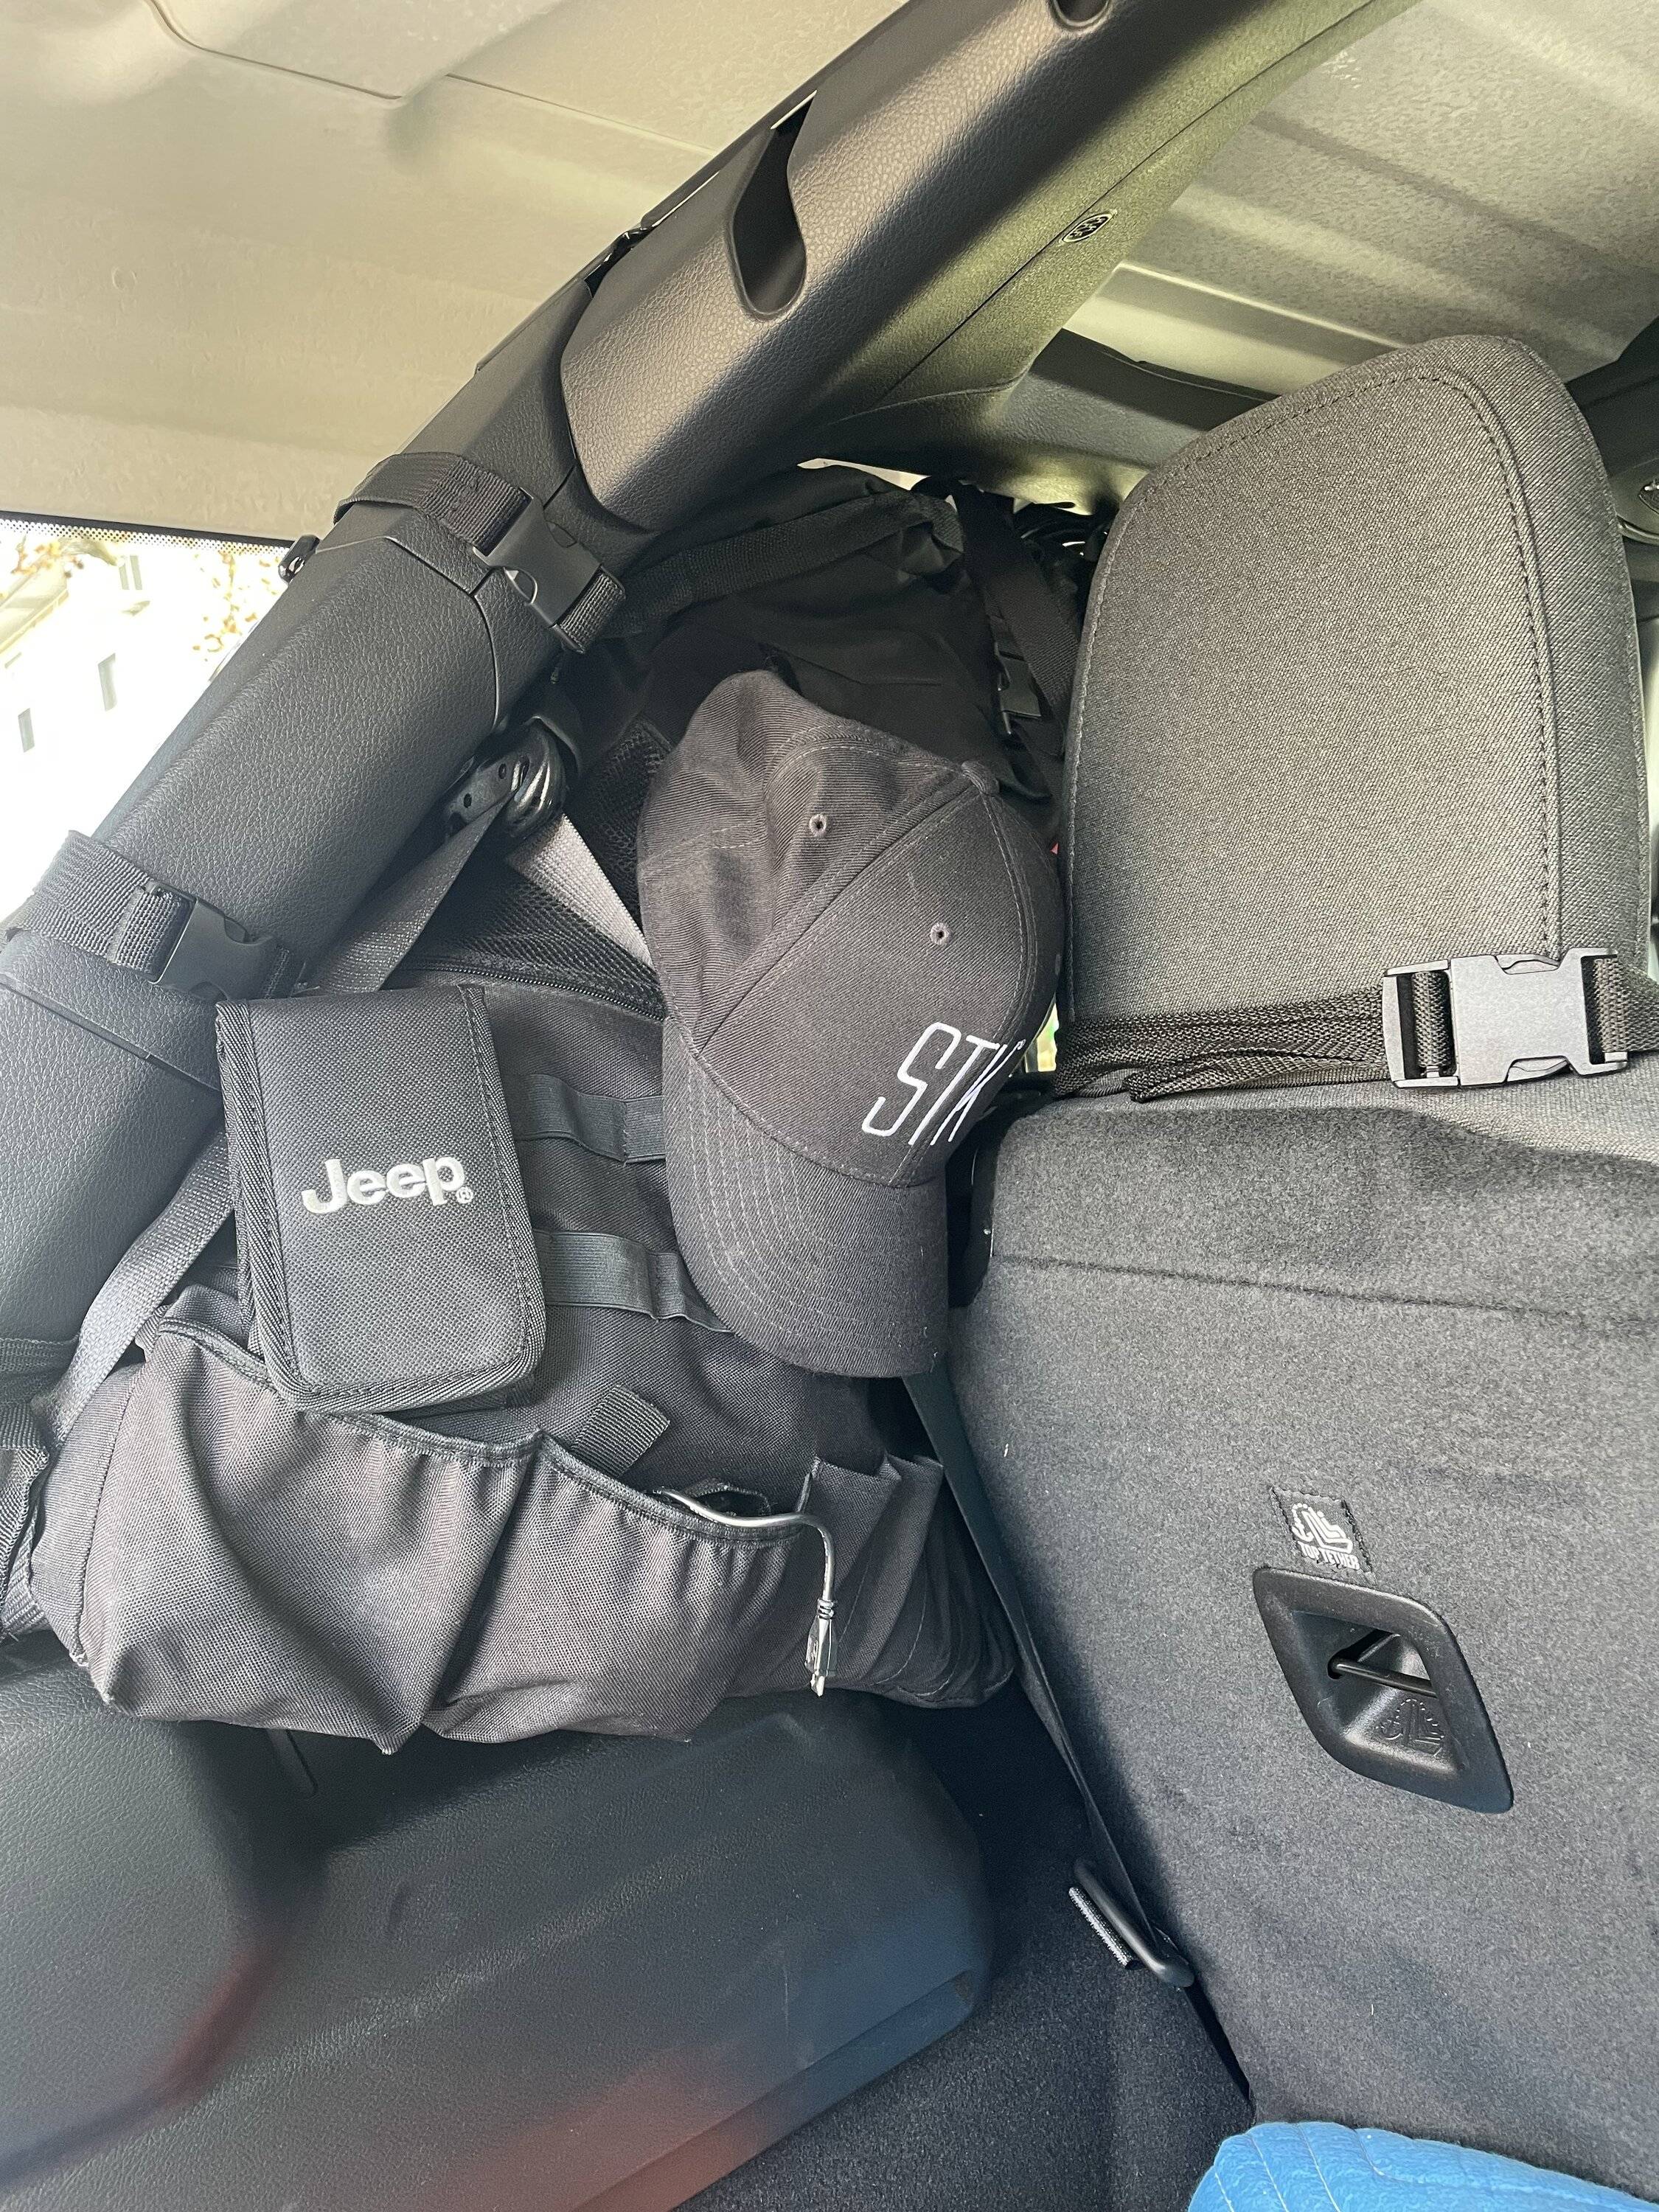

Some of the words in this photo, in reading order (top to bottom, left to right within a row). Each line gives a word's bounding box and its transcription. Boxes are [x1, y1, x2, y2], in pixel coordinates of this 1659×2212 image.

[861, 1022, 1026, 1145] STK
[1298, 1540, 1320, 1561] TOP
[1318, 1548, 1360, 1571] TETHER
